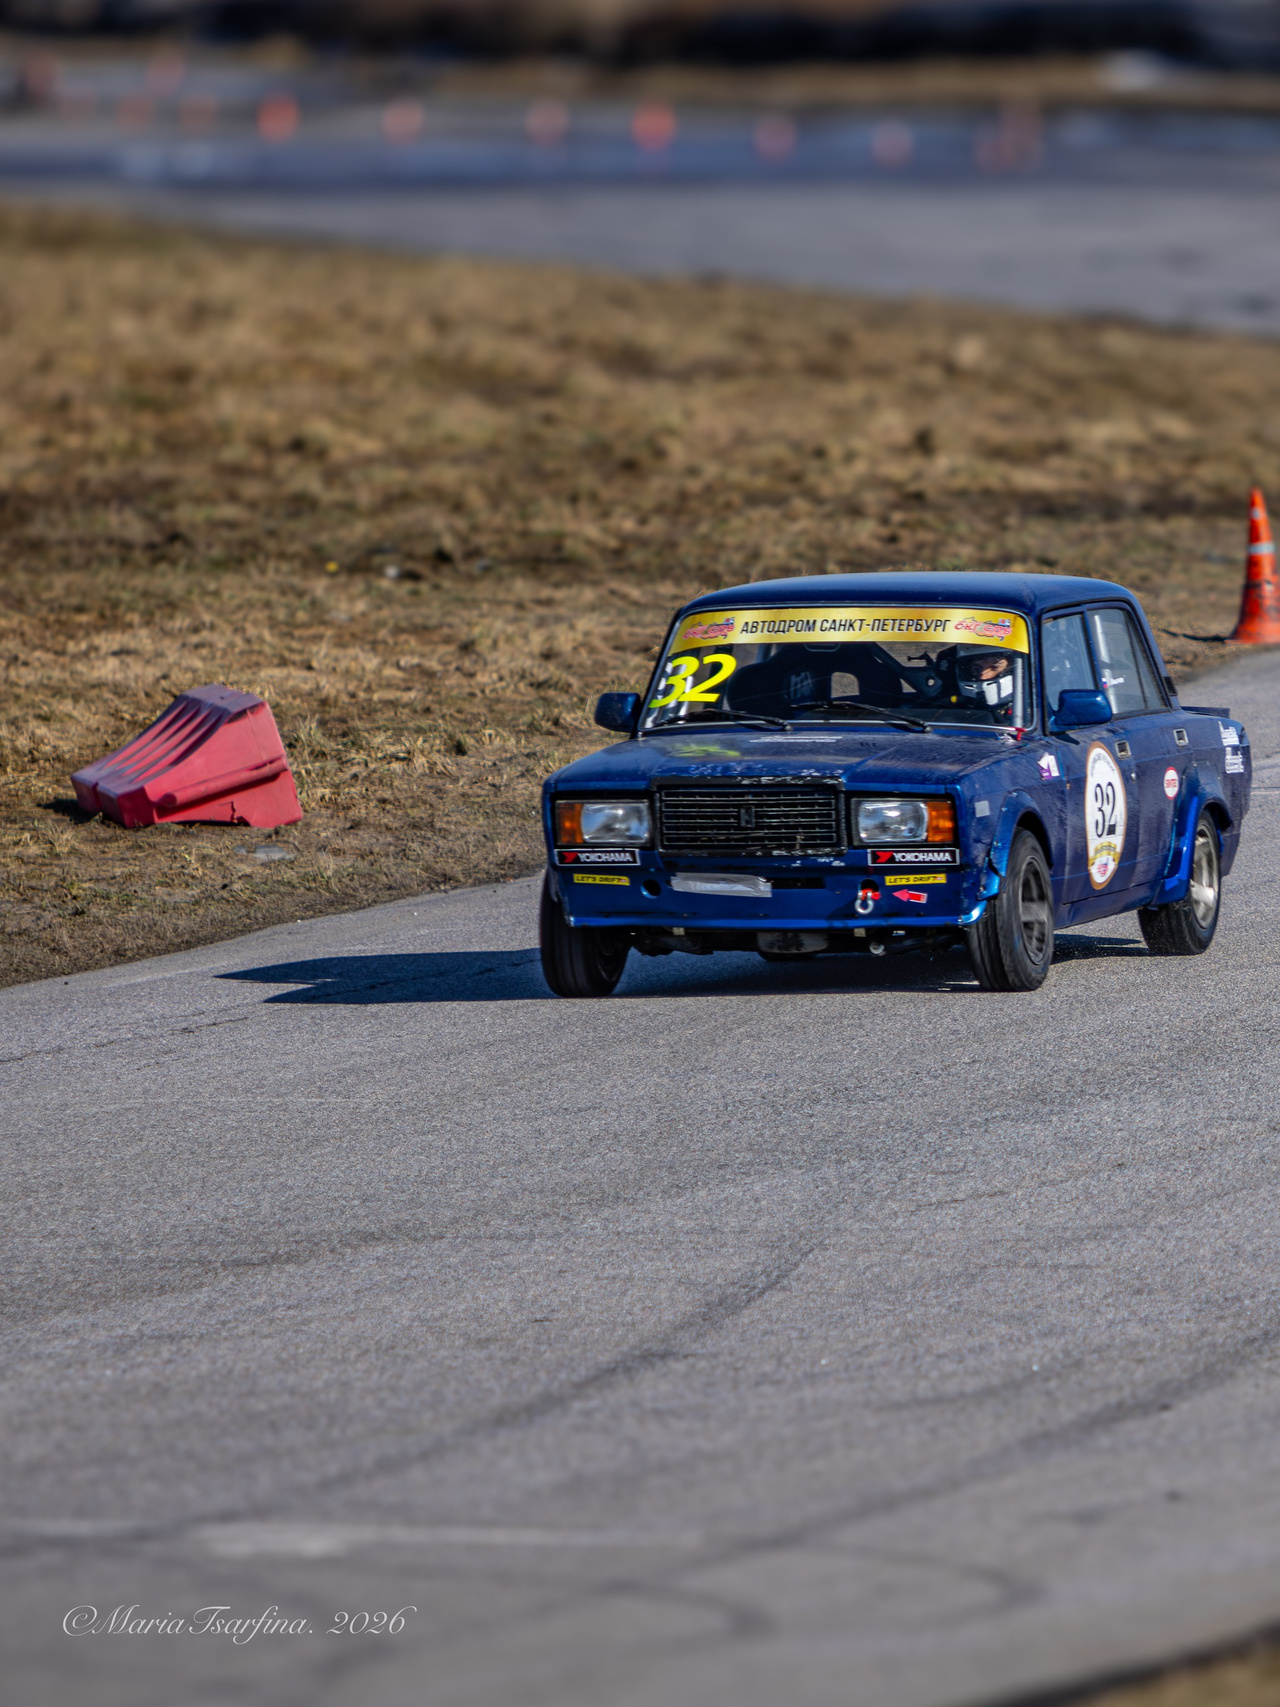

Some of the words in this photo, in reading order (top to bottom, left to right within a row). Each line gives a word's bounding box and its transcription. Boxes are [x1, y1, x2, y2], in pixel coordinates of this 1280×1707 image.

[740, 619, 816, 634] АВТОДРОМ
[819, 618, 950, 633] САНКТ-ПЕТЕРБУРГ
[648, 653, 737, 708] 32
[1094, 781, 1117, 839] 32
[577, 852, 634, 862] YOKOHAMA
[892, 852, 953, 862] YOKOHAMA
